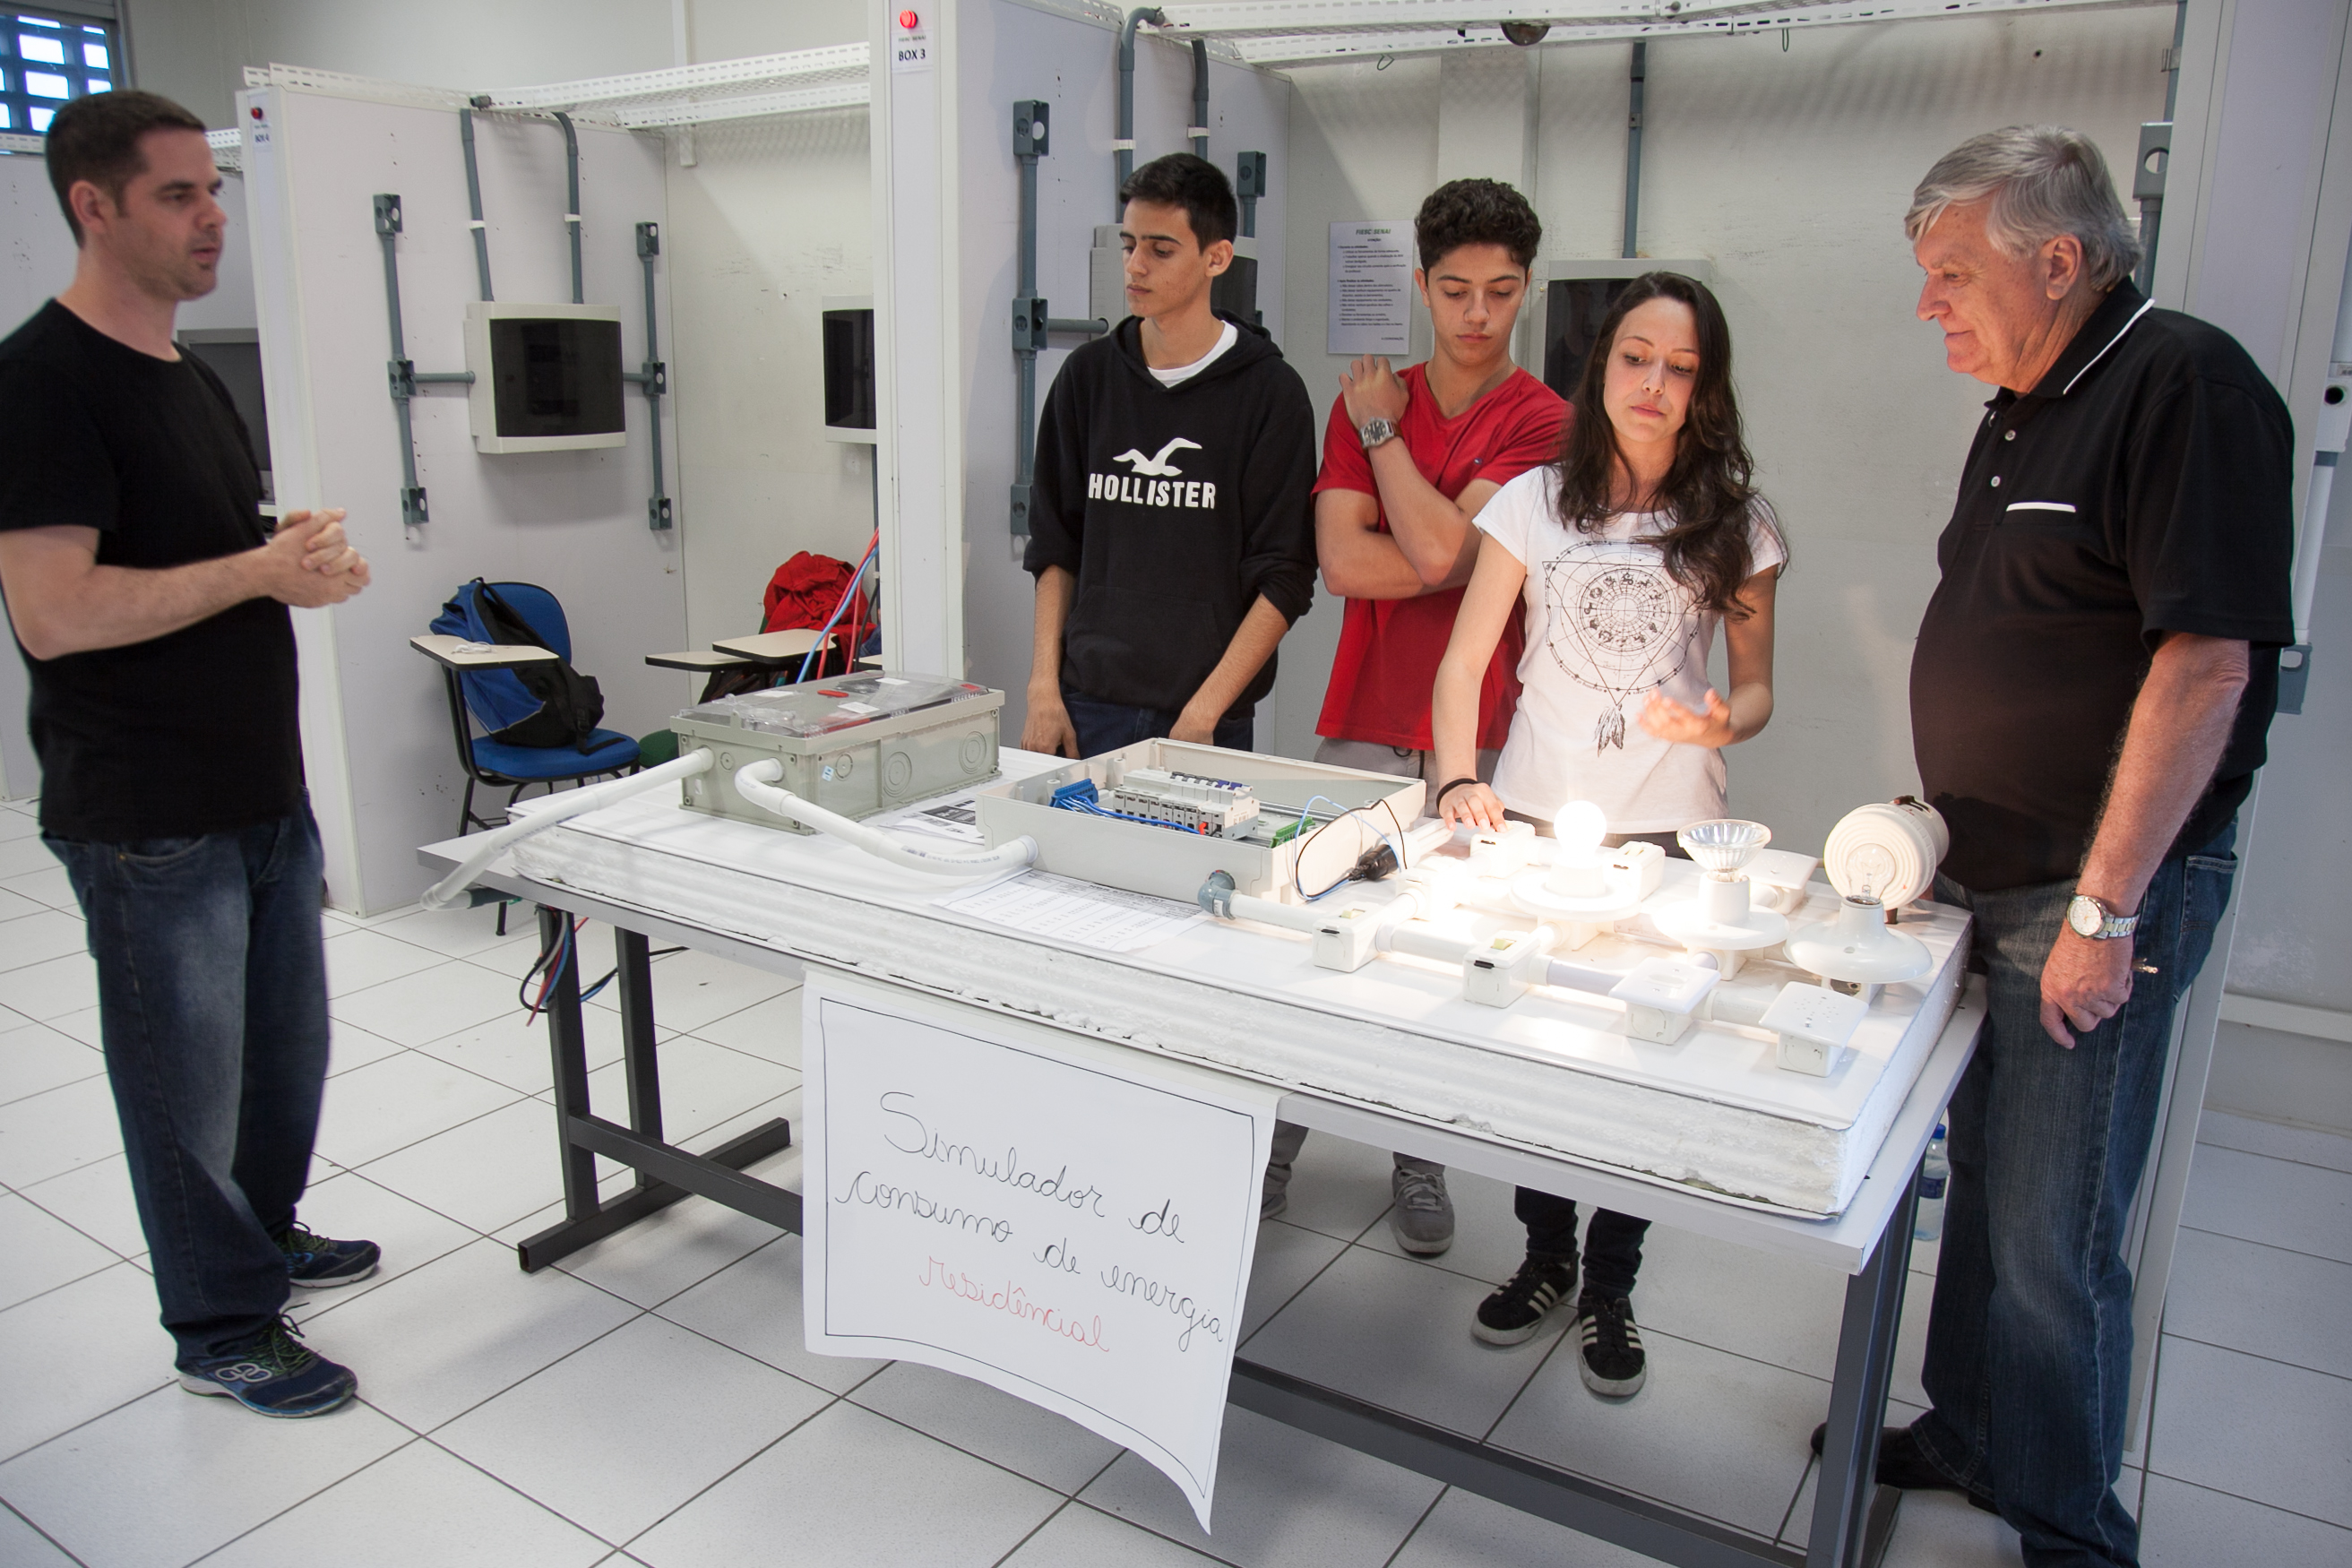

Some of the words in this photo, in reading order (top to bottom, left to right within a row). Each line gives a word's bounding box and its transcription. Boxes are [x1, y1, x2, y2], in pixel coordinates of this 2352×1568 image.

[899, 49, 918, 61] BOX
[920, 48, 926, 59] 3
[1088, 473, 1216, 509] HOLLISTER
[880, 1091, 1106, 1219] Simulador
[1128, 1199, 1185, 1244] de
[919, 1256, 1110, 1353] residêncial
[1033, 1237, 1081, 1274] de
[1101, 1265, 1224, 1352] energia
